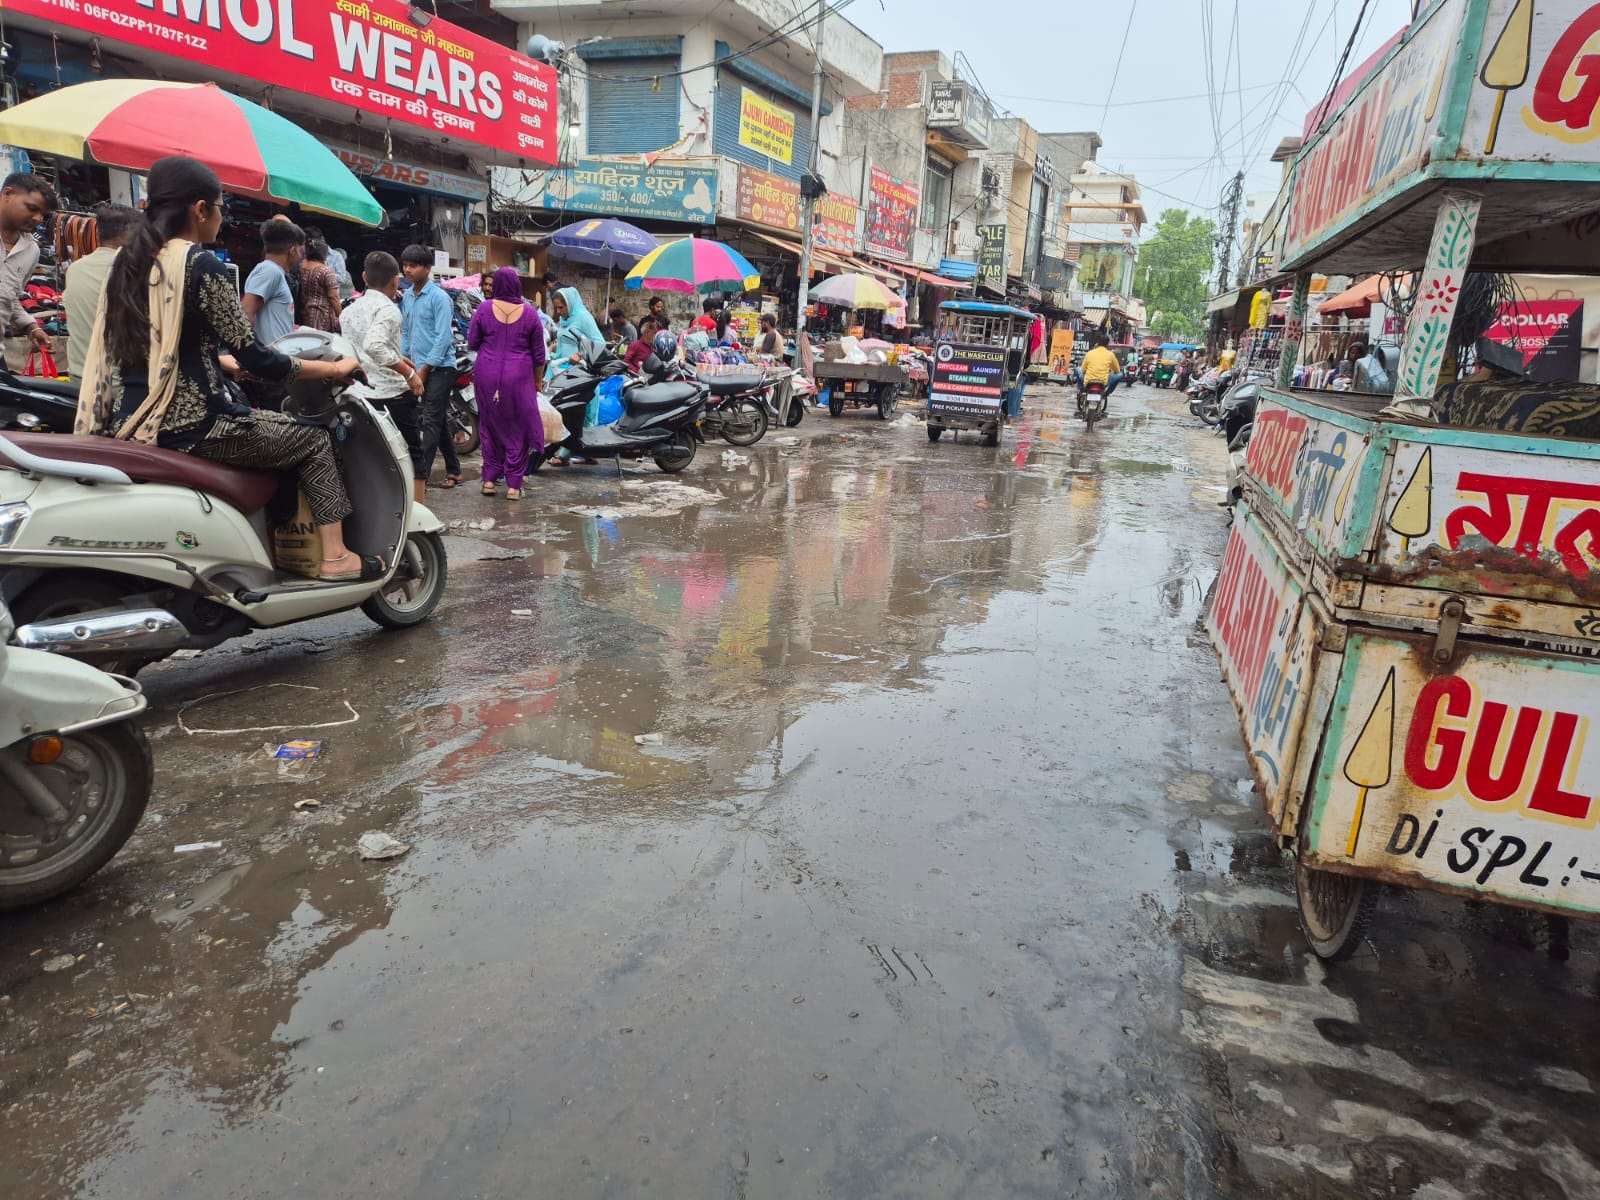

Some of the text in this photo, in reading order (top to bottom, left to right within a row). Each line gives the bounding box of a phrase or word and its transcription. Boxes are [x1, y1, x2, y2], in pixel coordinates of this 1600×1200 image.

[335, 0, 370, 21] स्वामी
[421, 27, 436, 46] जी
[437, 38, 474, 62] महाराज
[329, 12, 504, 121] WEARS
[512, 70, 549, 93] अनमोल
[330, 76, 476, 133] एक दाम की दुकान
[512, 88, 527, 104] की
[520, 113, 541, 129] वाली
[517, 131, 545, 149] दुकान
[574, 167, 640, 188] साहिल
[645, 175, 686, 198] शूज़
[630, 192, 656, 206] 400/-
[1501, 312, 1569, 328] DOLLAR
[972, 365, 1001, 374] LAUNDRY
[932, 403, 945, 411] FREE
[945, 404, 965, 413] PICKUP
[970, 407, 996, 416] DELIVERY
[1404, 675, 1592, 820] GUL
